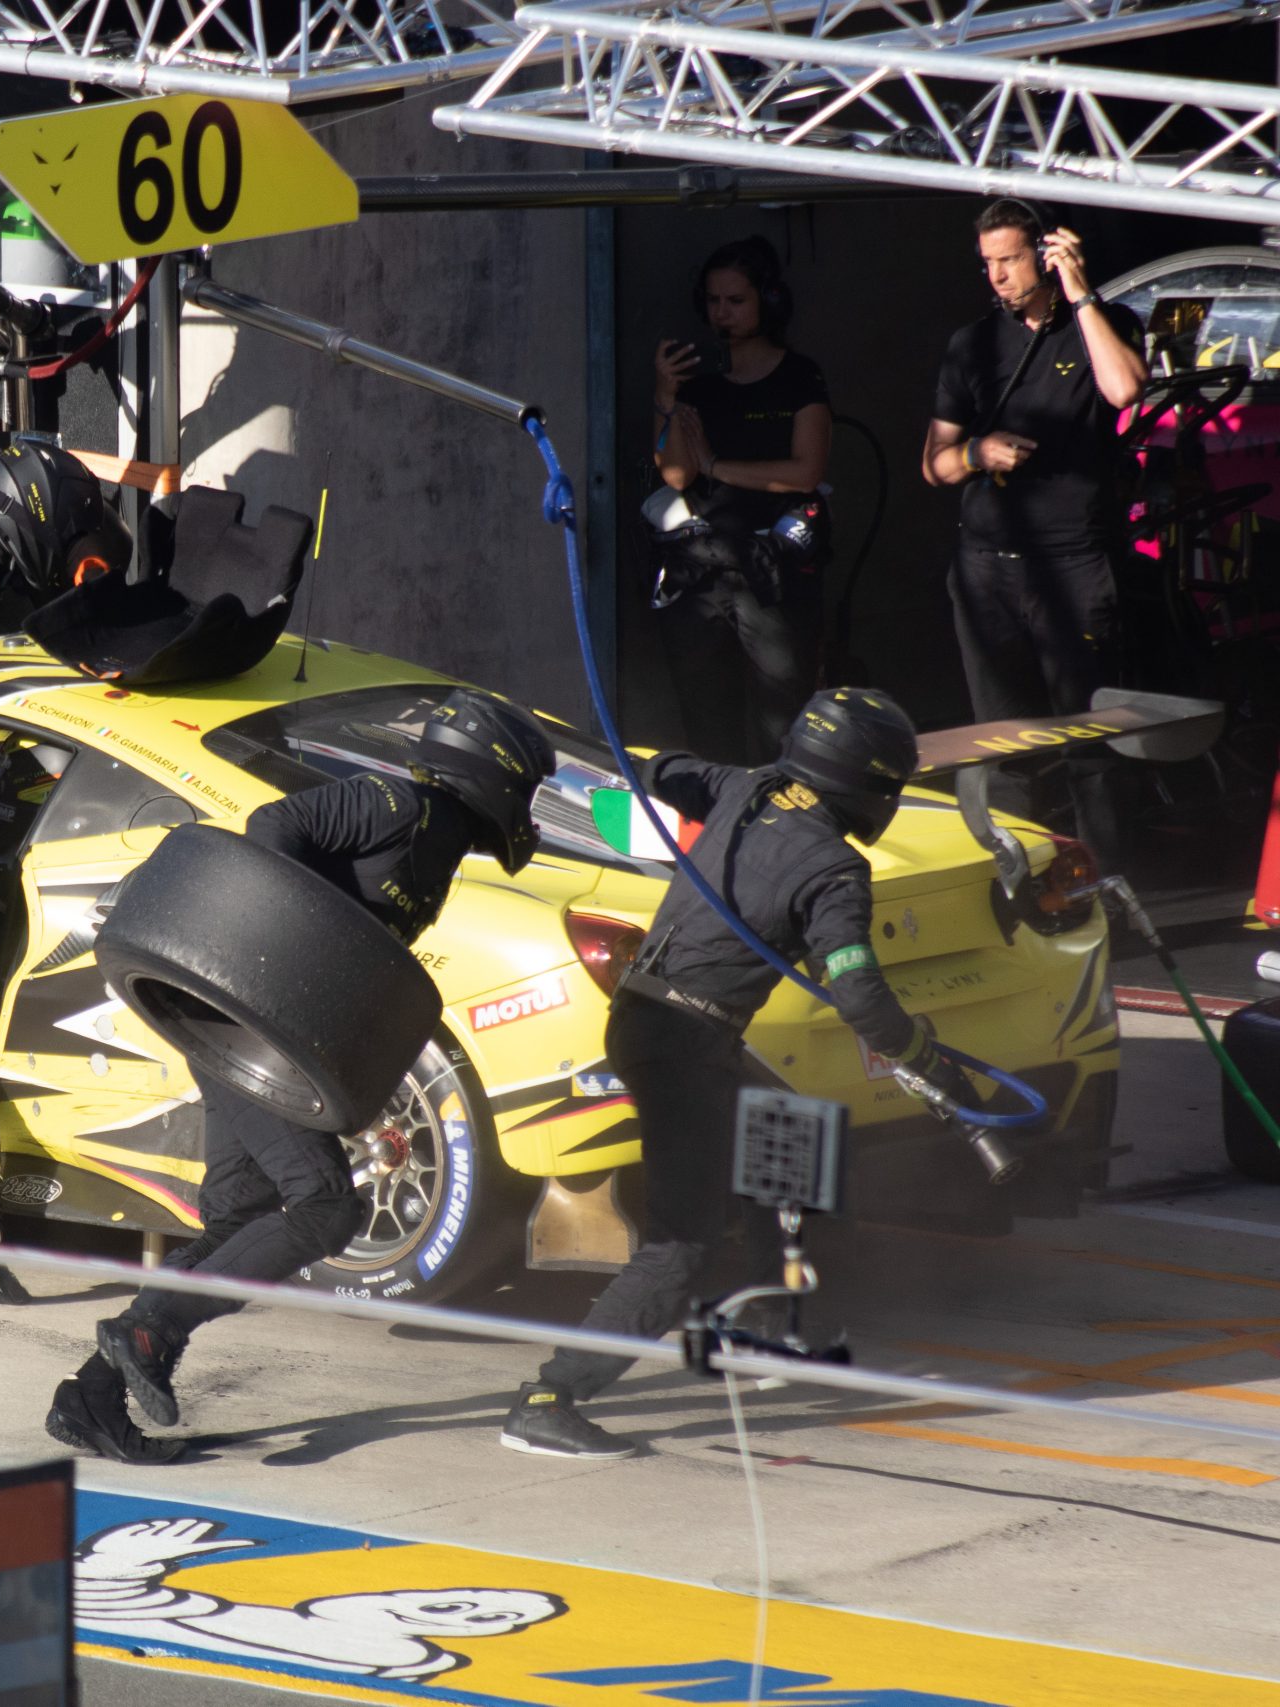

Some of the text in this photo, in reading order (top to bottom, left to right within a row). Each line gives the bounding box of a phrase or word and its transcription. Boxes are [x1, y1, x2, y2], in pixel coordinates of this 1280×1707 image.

[118, 101, 242, 245] 60
[28, 702, 242, 814] C.SCHIAVONI R.GIAMMARIA A.BALZAN
[974, 723, 1123, 754] IRON
[940, 970, 985, 990] LYNX
[475, 983, 568, 1030] MOTUL
[3, 1178, 61, 1202] Beretta
[423, 1147, 469, 1271] MICHELIN
